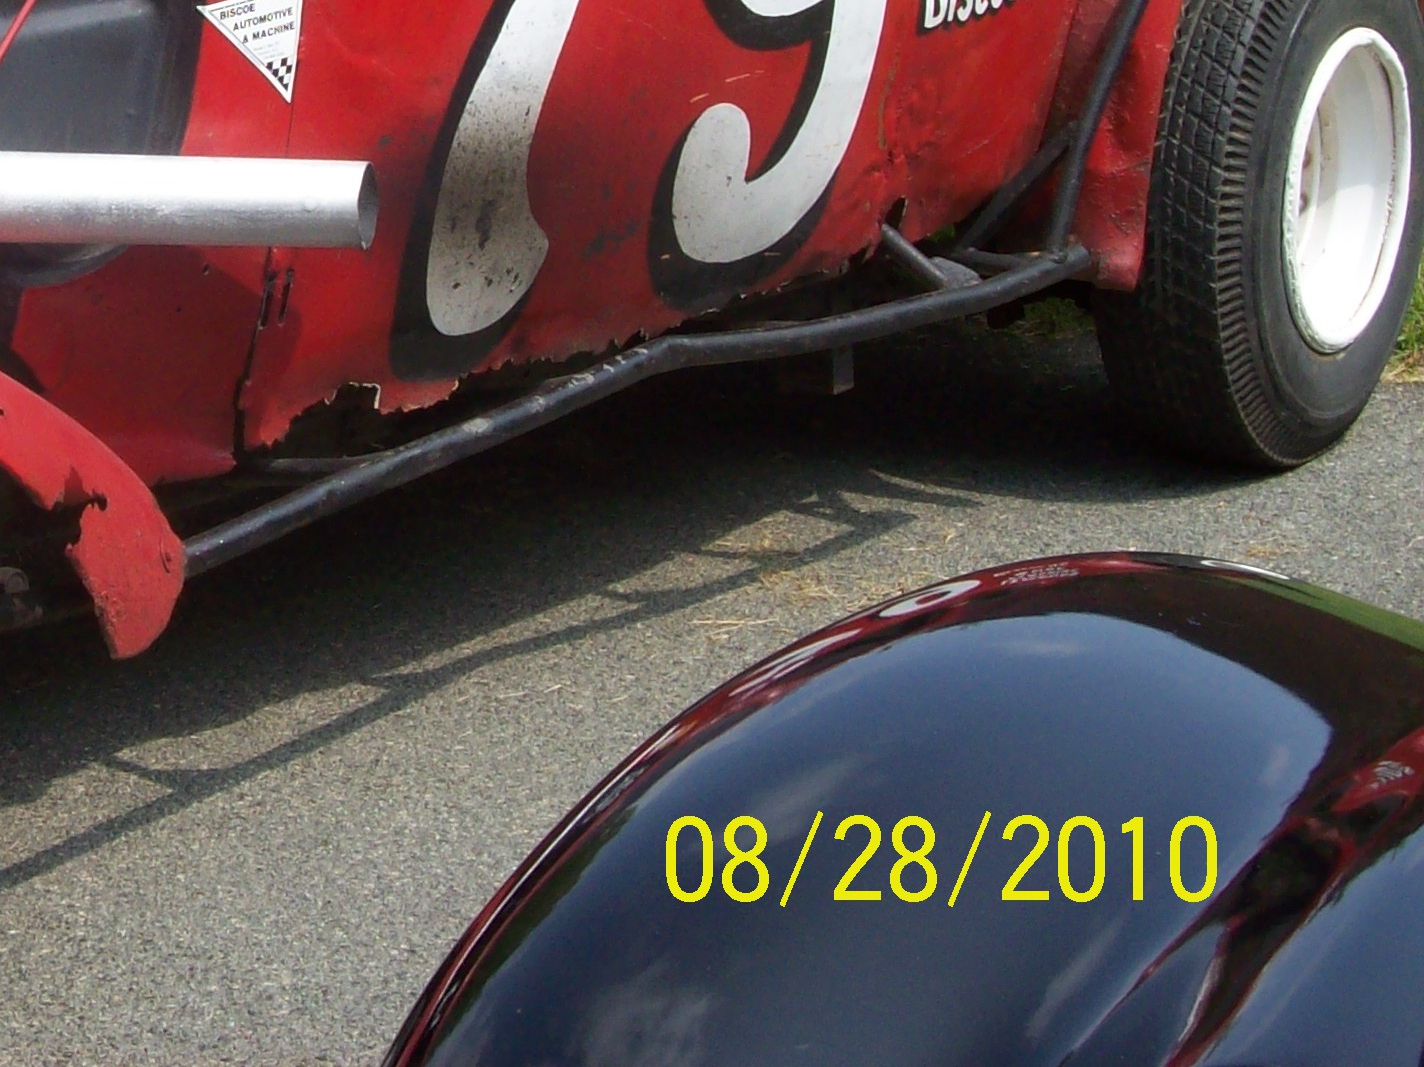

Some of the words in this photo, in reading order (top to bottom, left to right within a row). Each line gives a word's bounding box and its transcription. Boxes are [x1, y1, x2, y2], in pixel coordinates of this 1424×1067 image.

[220, 3, 256, 20] BISCOE
[233, 7, 293, 31] AUTOMOTIVE
[252, 21, 295, 40] MACHINE
